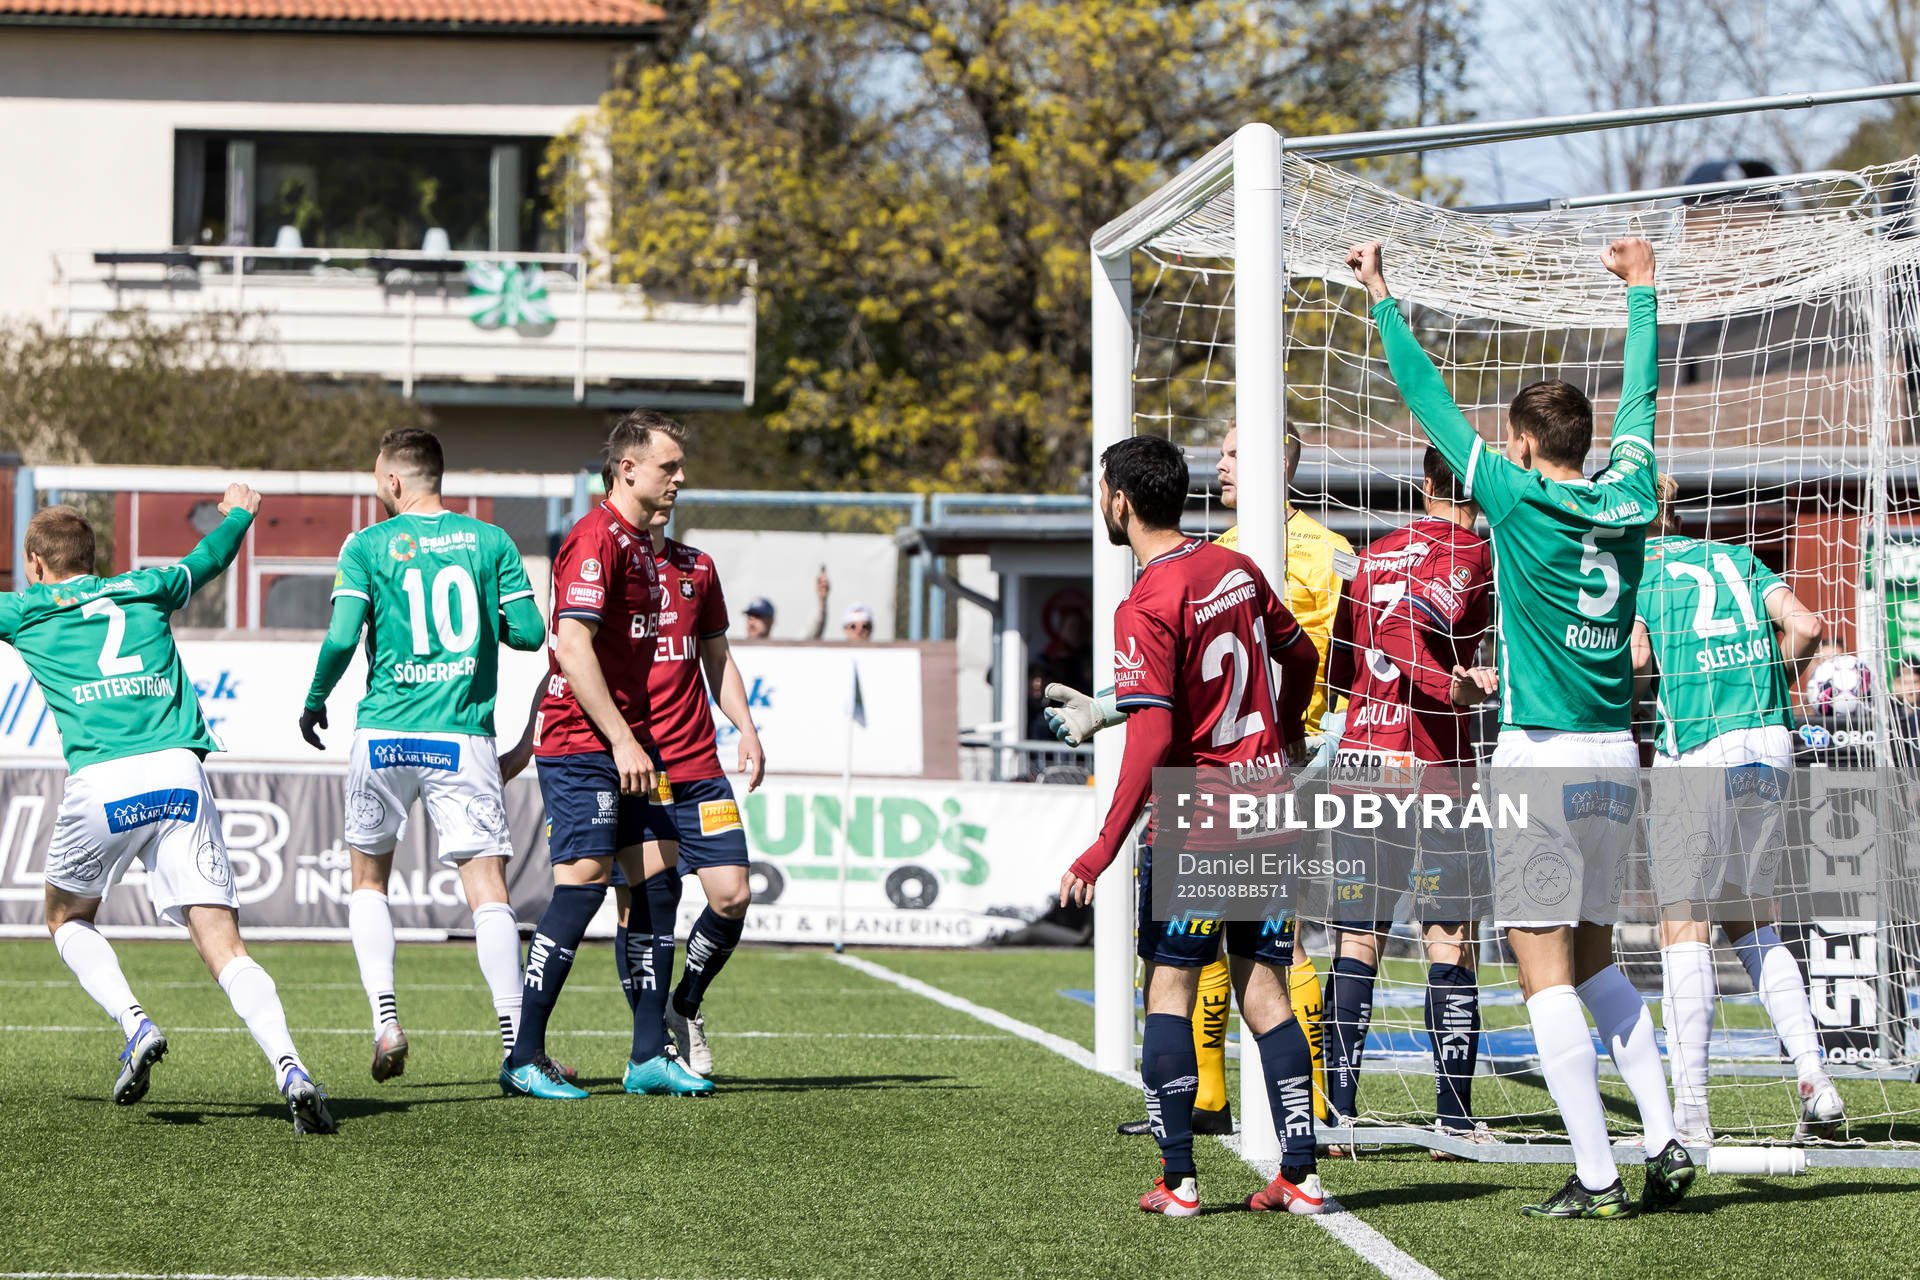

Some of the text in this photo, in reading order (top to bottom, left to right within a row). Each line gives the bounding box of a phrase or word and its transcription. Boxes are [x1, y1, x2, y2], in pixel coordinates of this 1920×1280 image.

[1577, 525, 1626, 617] 5
[402, 565, 480, 656] 10
[570, 586, 603, 599] UNIBET
[1665, 553, 1760, 639] 21
[81, 597, 144, 677] 2
[1565, 620, 1619, 649] RÖDIN
[71, 672, 176, 704] ZETTERSTRÖM
[394, 657, 479, 684] SÖDERBER
[1114, 670, 1147, 682] QUALITY
[1118, 680, 1140, 688] HOTEL
[1201, 615, 1279, 748] 21
[1832, 730, 1877, 747] OBO
[383, 752, 452, 767] AB KARL HEDIN
[1332, 751, 1383, 784] BESAB
[125, 812, 139, 826] AB
[140, 808, 163, 821] KARL
[704, 804, 737, 817] TRIUM
[1810, 762, 1877, 1026] SELECT
[825, 917, 973, 937] PLANERING
[524, 932, 557, 991] MIKE
[627, 932, 657, 991] MIKE
[685, 931, 719, 976] MIKE
[1202, 992, 1229, 1049] MIKE
[1303, 1003, 1323, 1061] MIKE
[1442, 994, 1475, 1061] MIKE
[1338, 1055, 1348, 1088] umbro
[1276, 1075, 1313, 1139] MIKE
